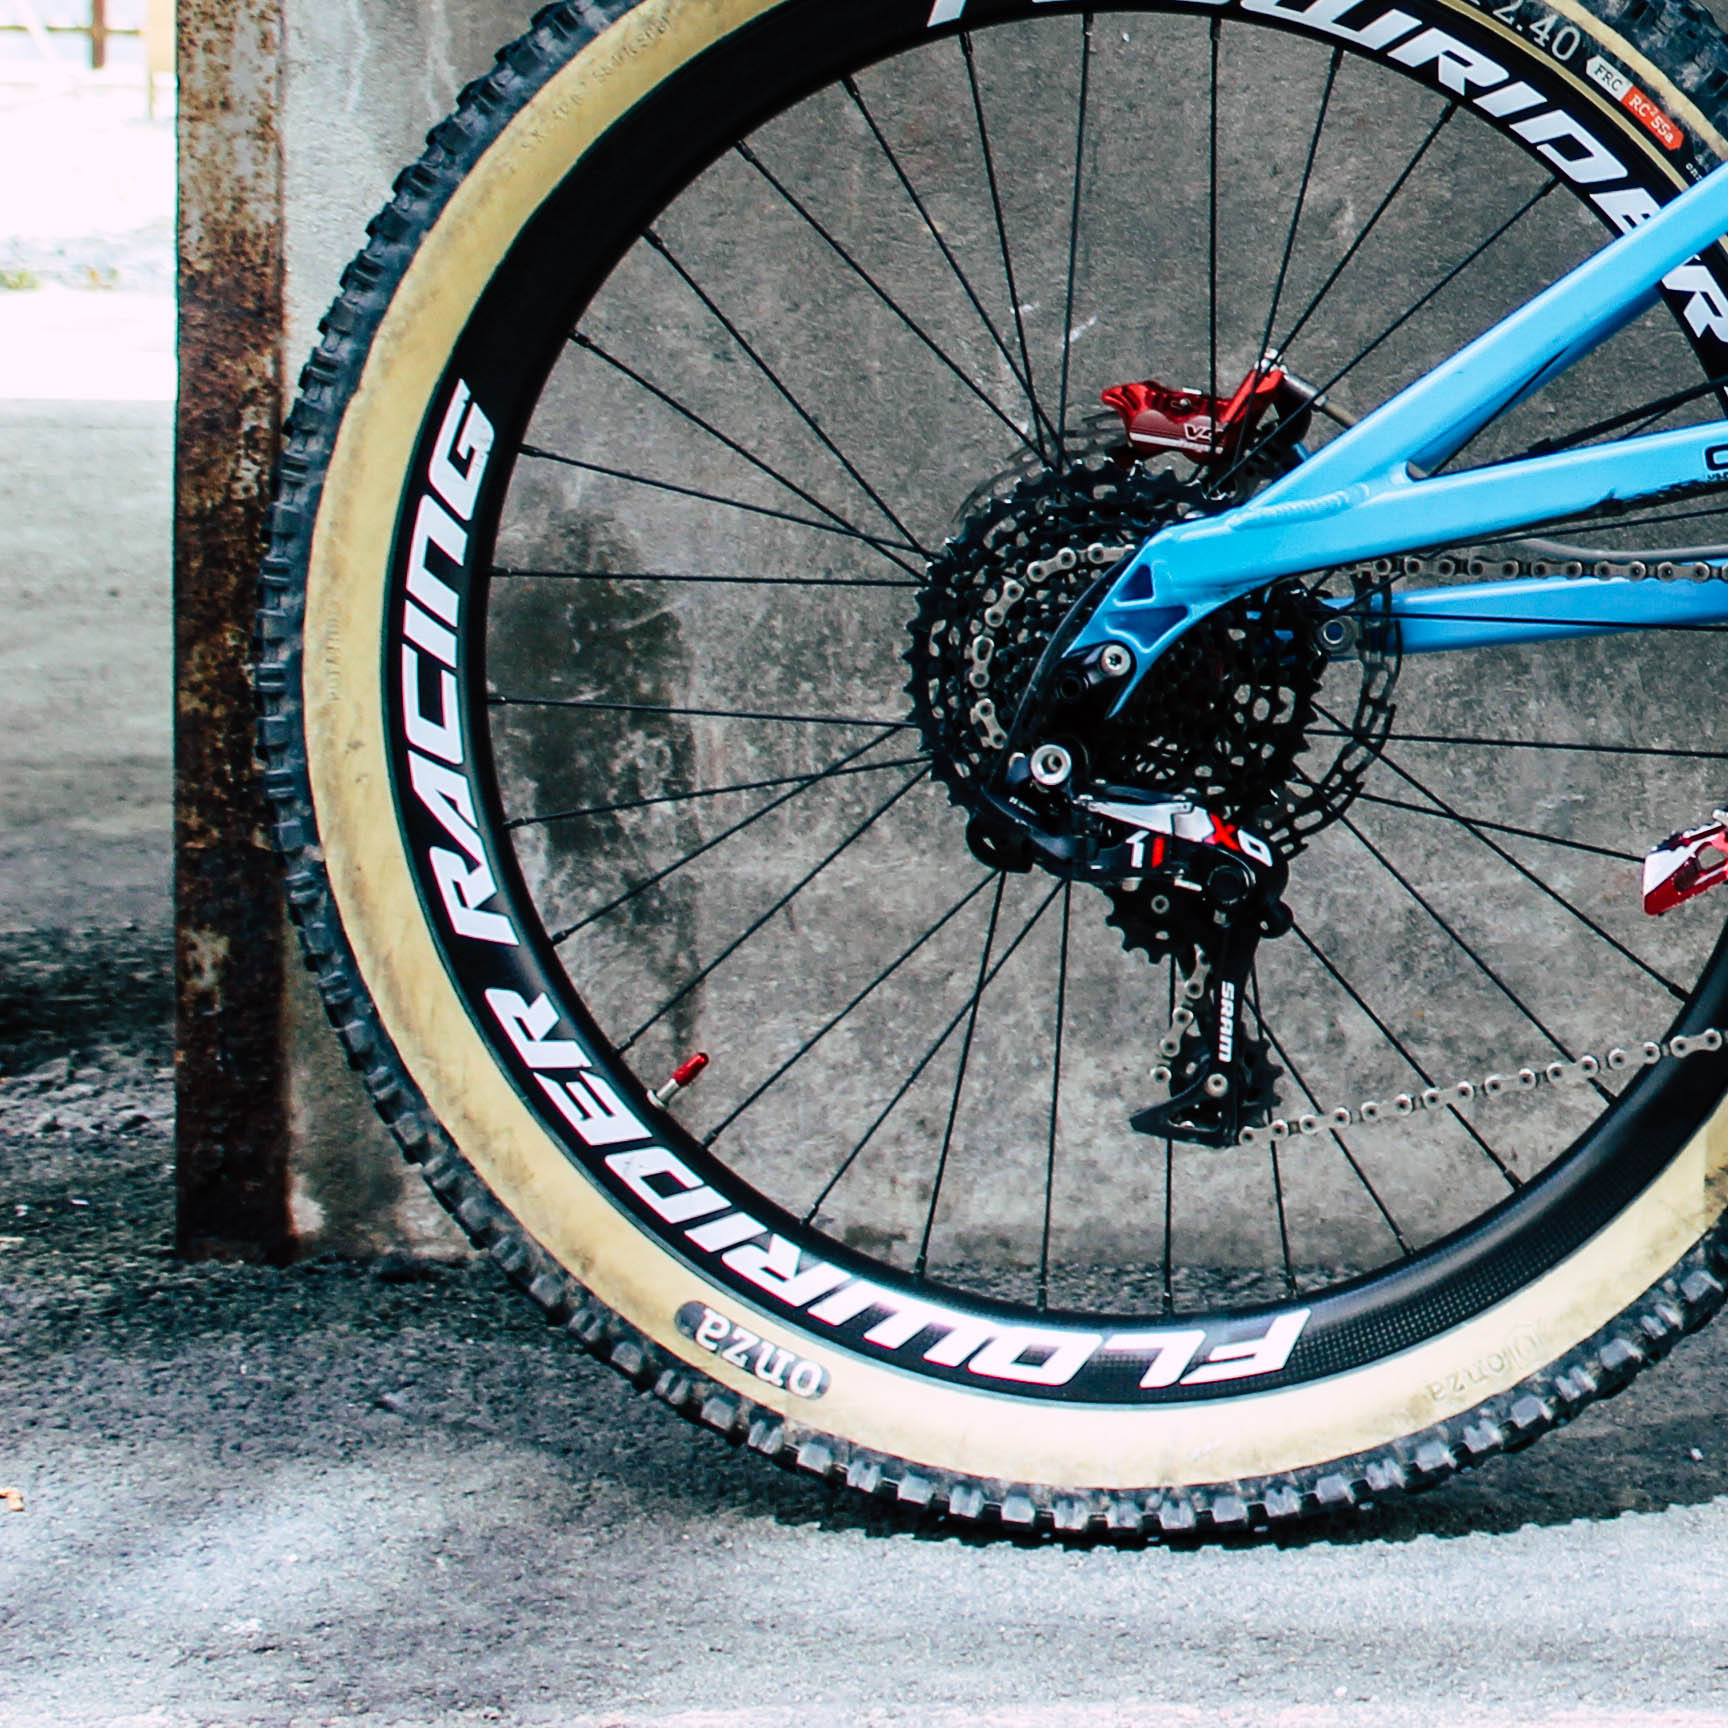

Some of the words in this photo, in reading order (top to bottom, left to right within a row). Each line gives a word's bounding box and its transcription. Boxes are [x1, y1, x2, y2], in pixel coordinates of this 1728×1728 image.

[1593, 63, 1624, 92] FRC
[401, 377, 519, 947] RACING
[1219, 979, 1237, 1064] SRAM
[482, 987, 1313, 1390] FLOWRIDER
[696, 1305, 826, 1400] onza
